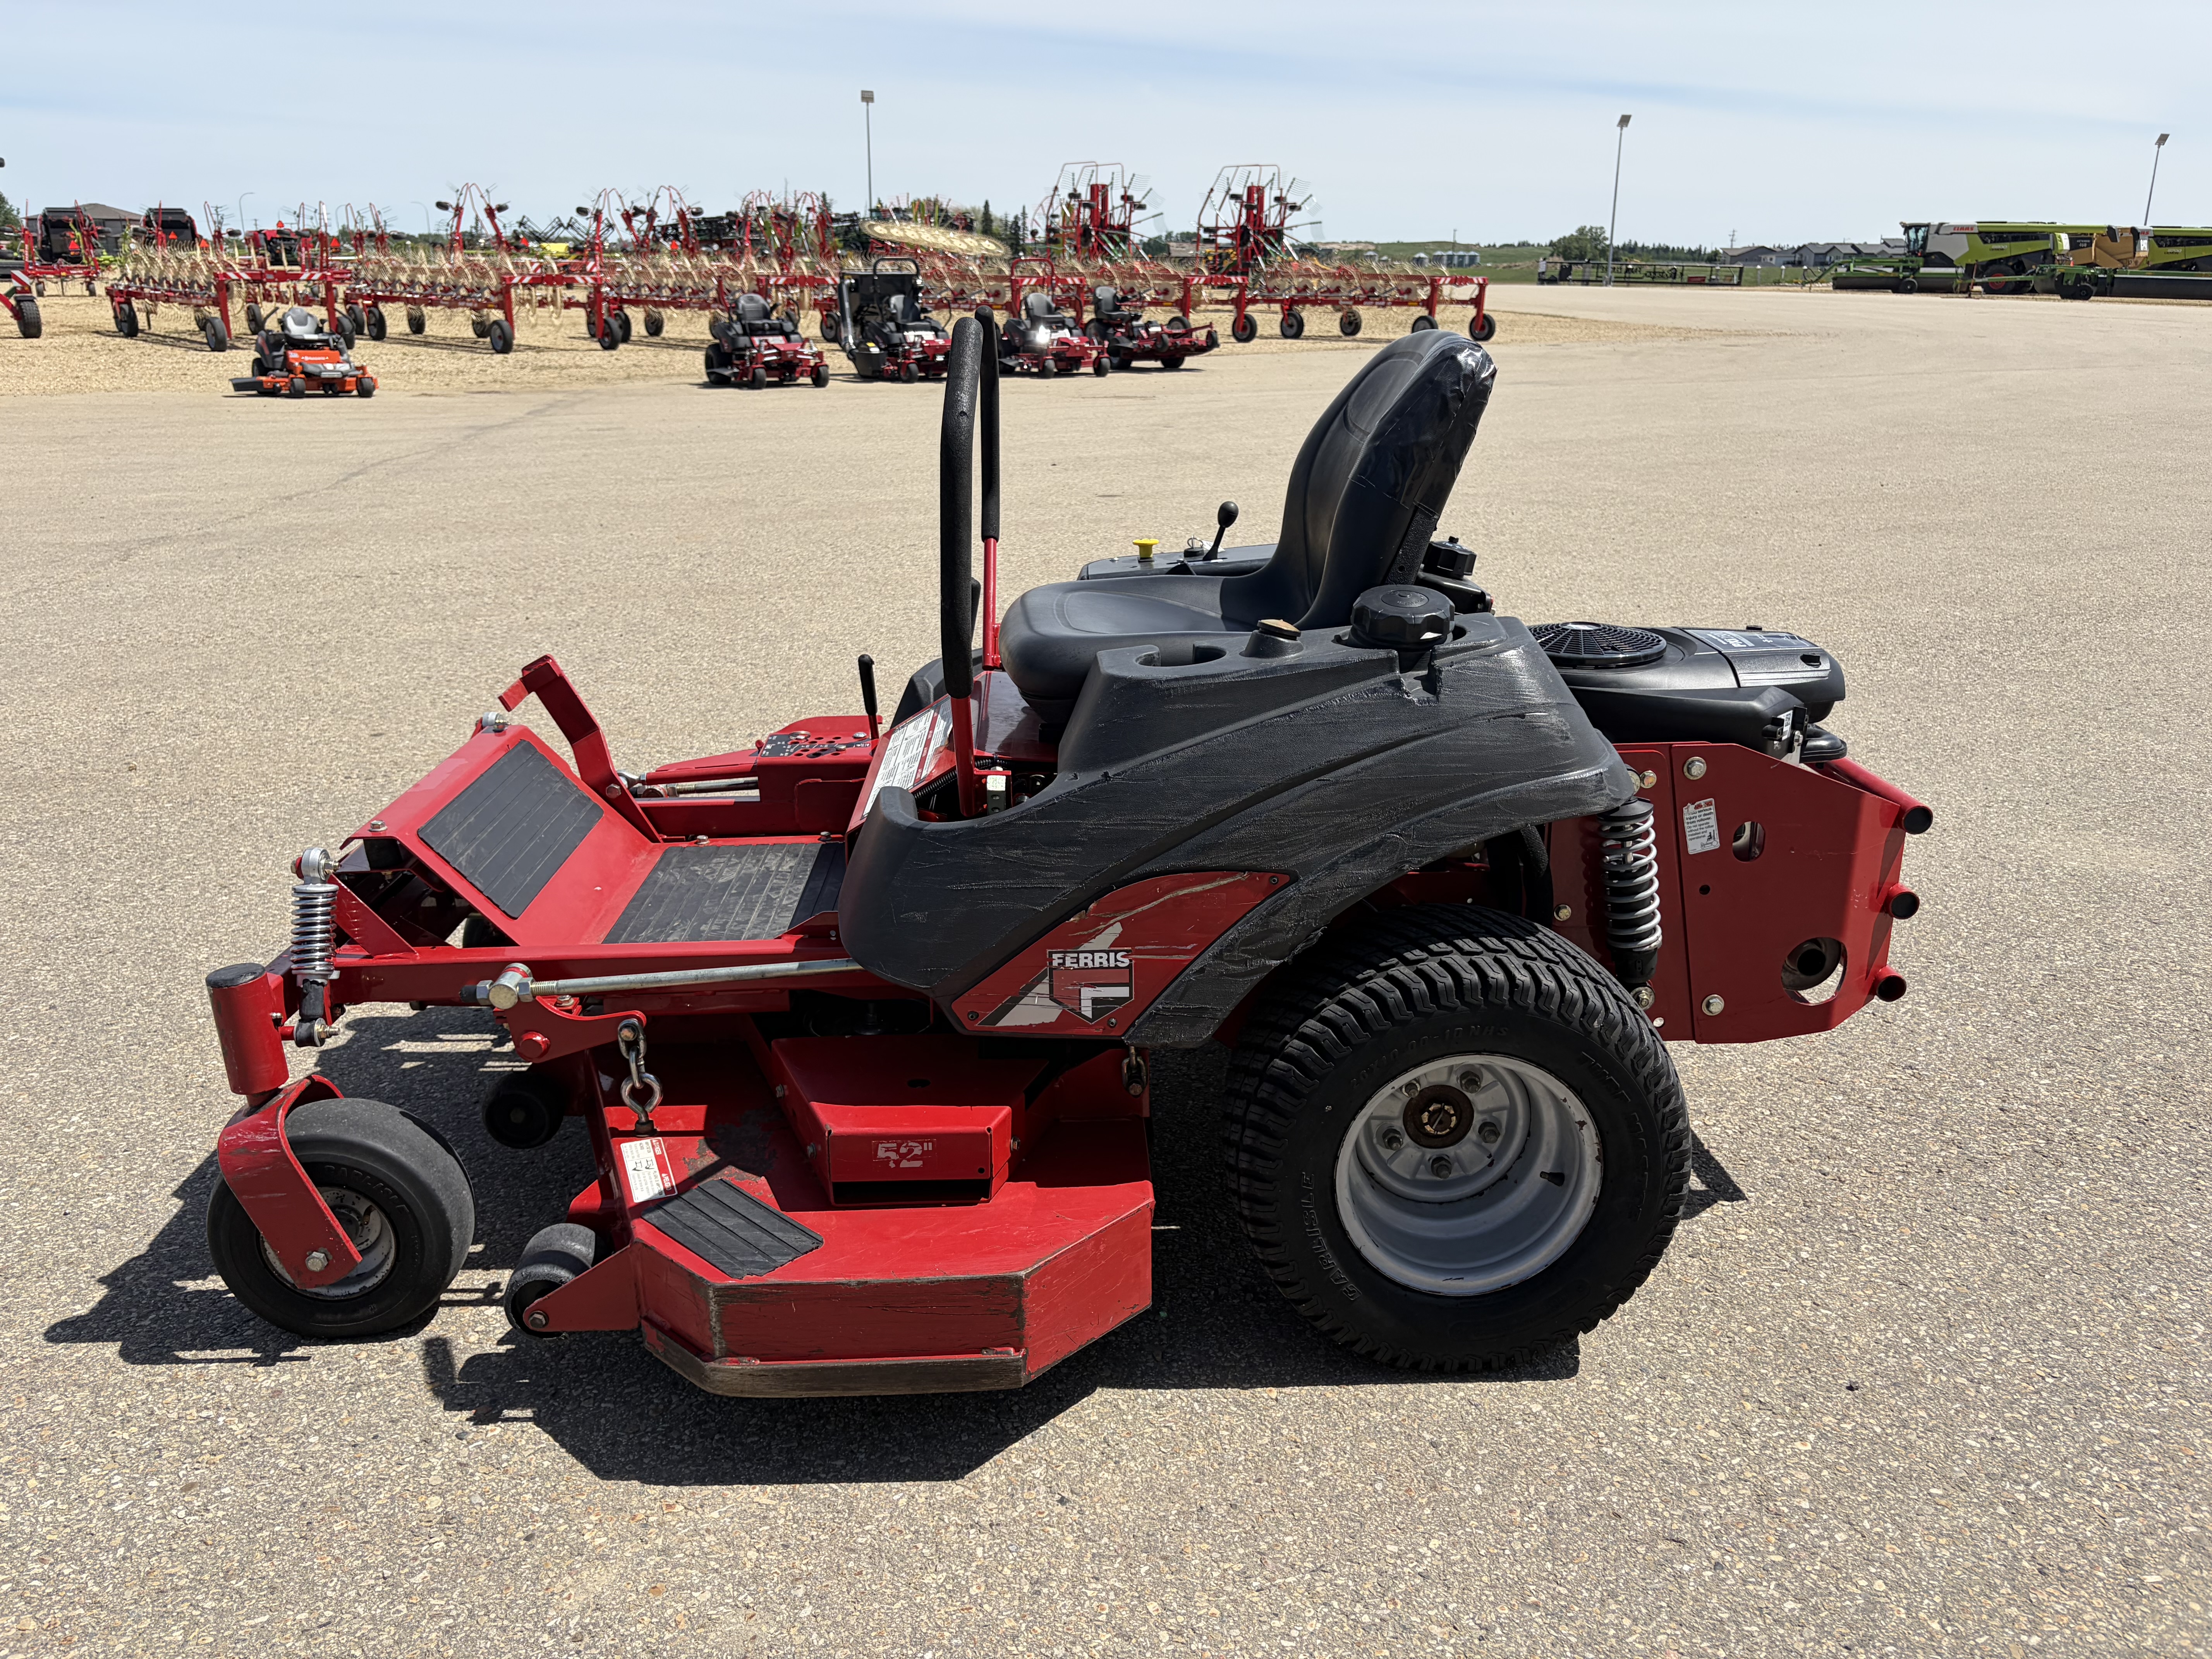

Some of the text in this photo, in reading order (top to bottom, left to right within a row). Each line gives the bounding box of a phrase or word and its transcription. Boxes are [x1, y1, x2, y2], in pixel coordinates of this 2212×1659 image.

[1052, 951, 1130, 967] FERRIS
[1469, 1025, 1510, 1037] NHS
[653, 1142, 662, 1155] DANGER
[1301, 1171, 1363, 1301] CARLISLE
